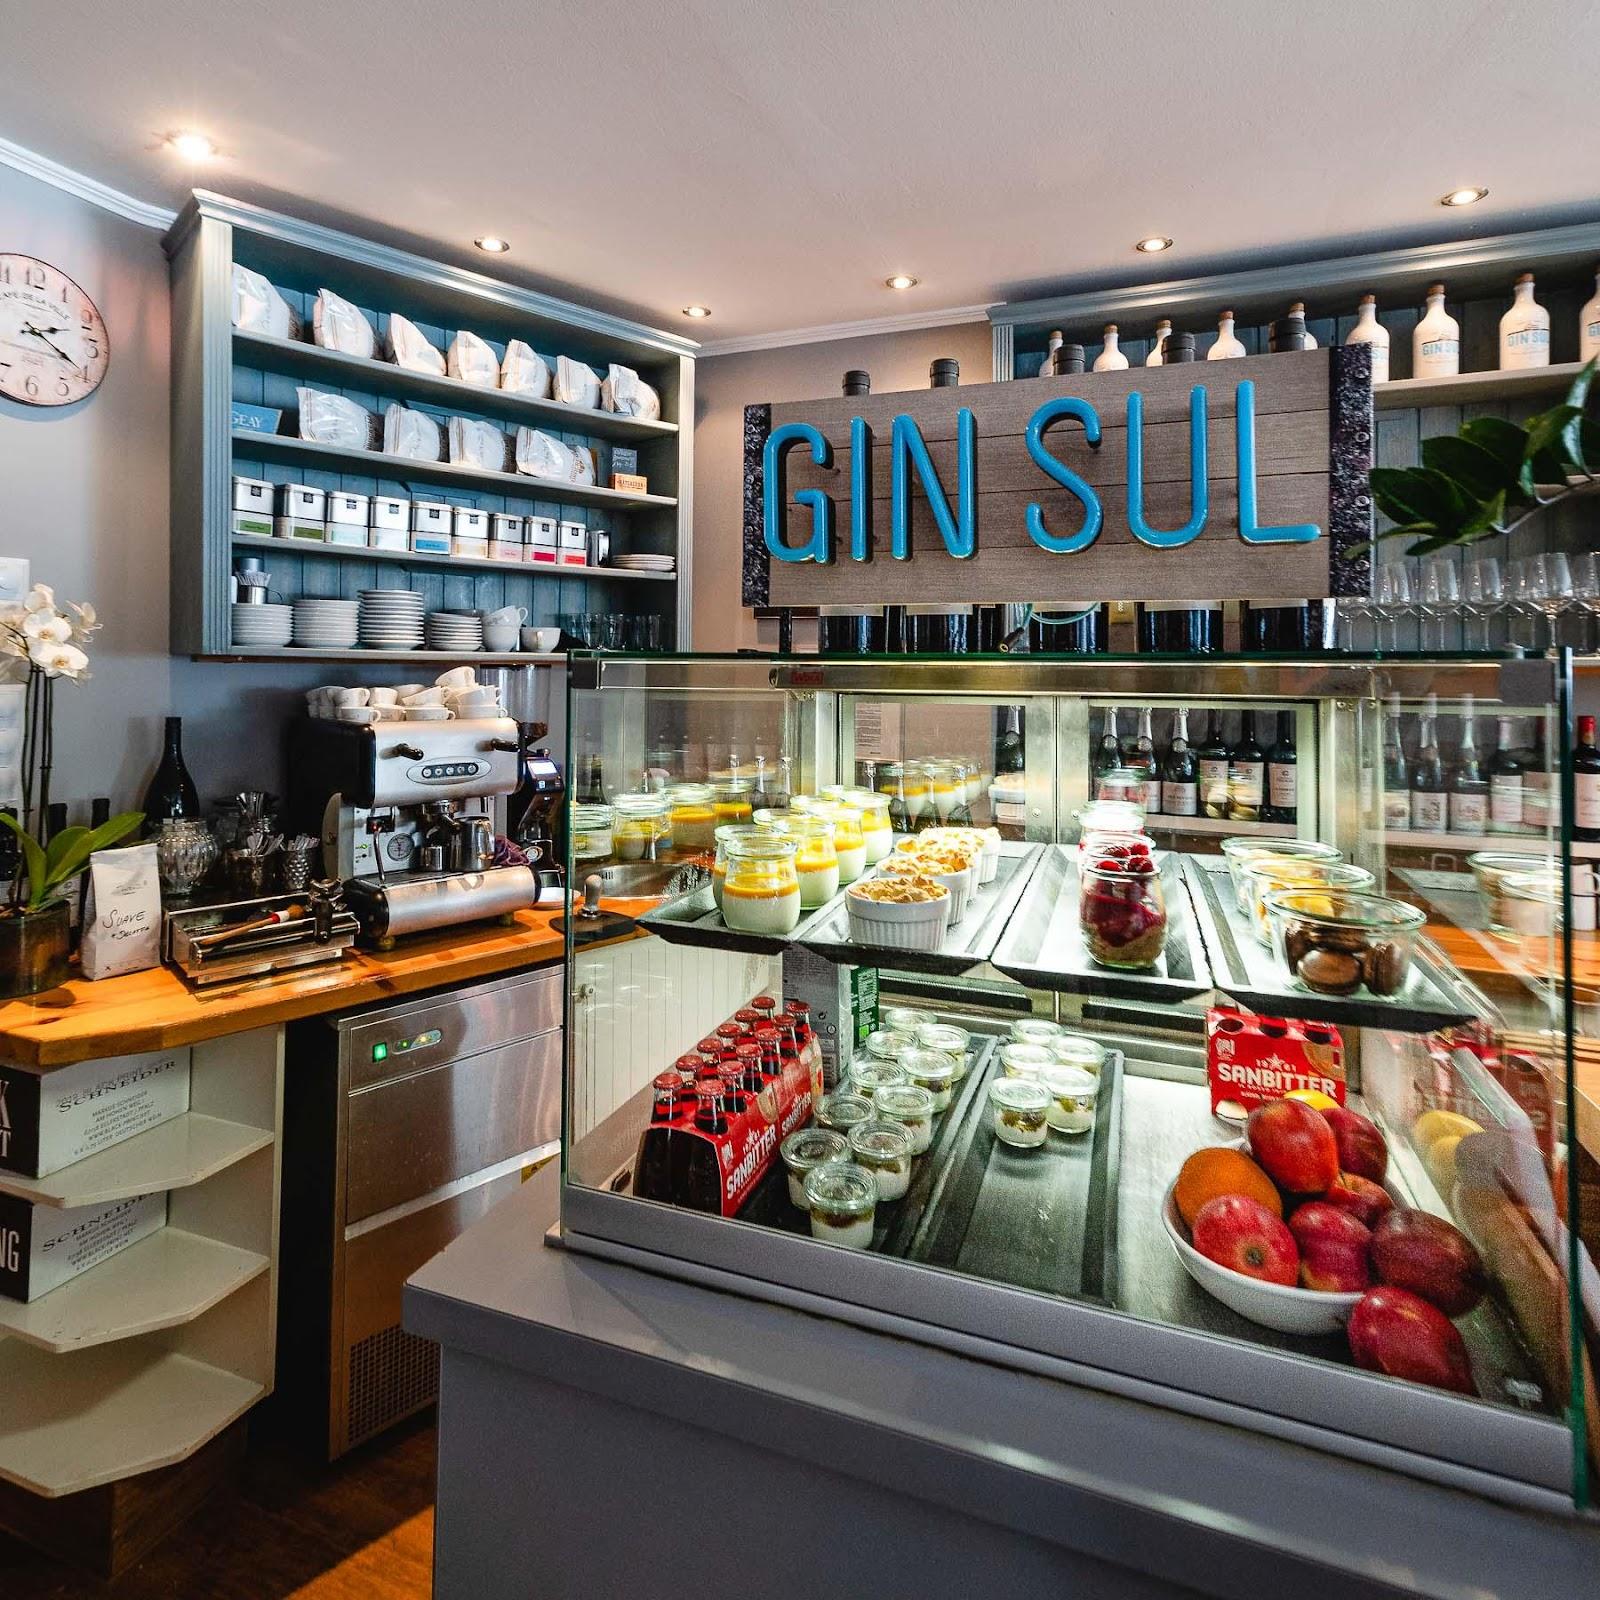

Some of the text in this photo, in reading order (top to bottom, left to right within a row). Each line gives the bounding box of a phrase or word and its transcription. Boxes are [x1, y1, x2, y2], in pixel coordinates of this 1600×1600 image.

[25, 375, 39, 397] 6
[763, 379, 1321, 564] GIN SUL
[58, 1061, 176, 1113] SCHNEIDER
[1217, 1062, 1338, 1099] SANBITTER
[727, 1123, 777, 1200] SANBITTER
